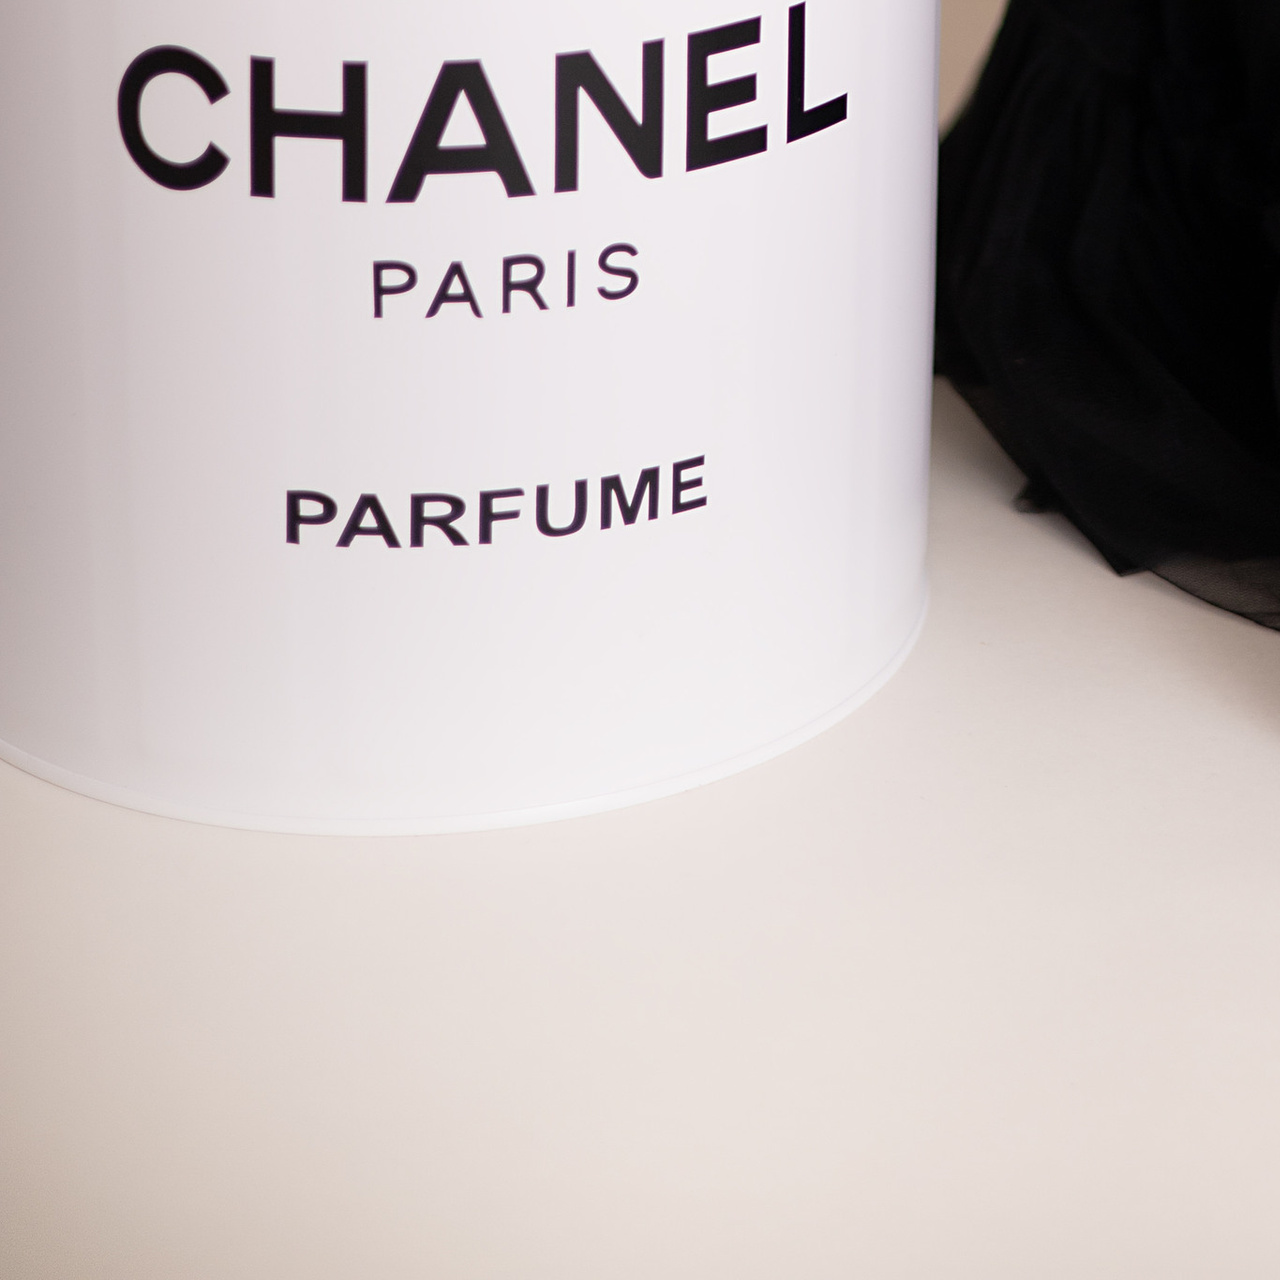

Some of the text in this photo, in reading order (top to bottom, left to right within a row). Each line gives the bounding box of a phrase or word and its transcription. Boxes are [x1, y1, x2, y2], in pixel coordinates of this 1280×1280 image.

[115, 0, 849, 204] CHANEL
[372, 242, 640, 320] PARIS
[285, 454, 708, 549] PARFUME
